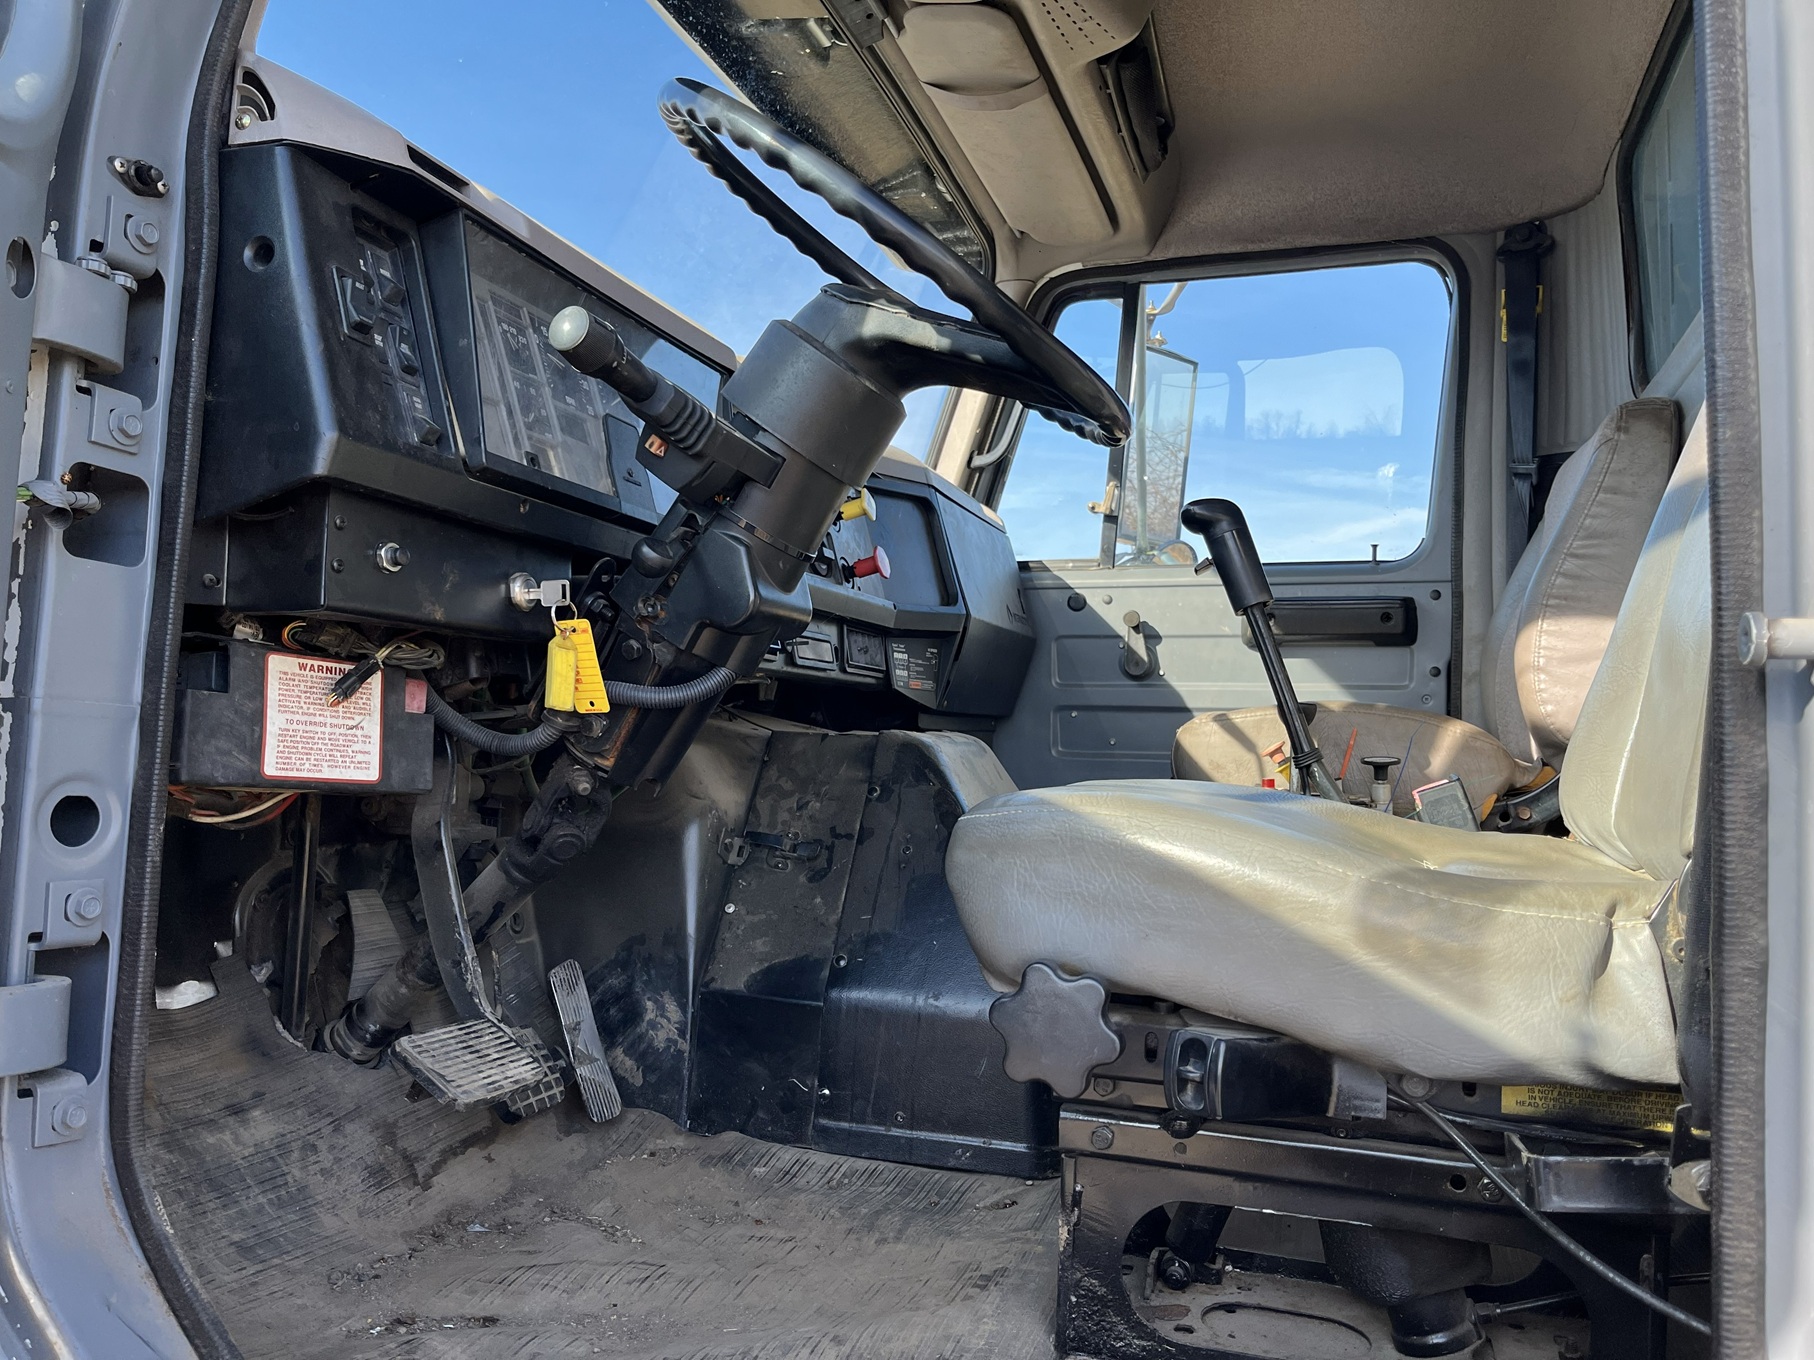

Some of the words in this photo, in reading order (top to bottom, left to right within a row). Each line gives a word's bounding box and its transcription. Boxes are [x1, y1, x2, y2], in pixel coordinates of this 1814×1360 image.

[298, 662, 346, 676] WARNIN
[296, 719, 328, 728] OVERRIDE
[329, 722, 364, 731] SHUTDOWN
[1515, 1099, 1539, 1108] HEAD
[1609, 1110, 1650, 1119] MAXIMUM
[1579, 1100, 1613, 1109] ENSURE
[1639, 1106, 1666, 1114] THERE
[1607, 1096, 1642, 1105] BEFORE
[1644, 1099, 1680, 1108] DRIVING
